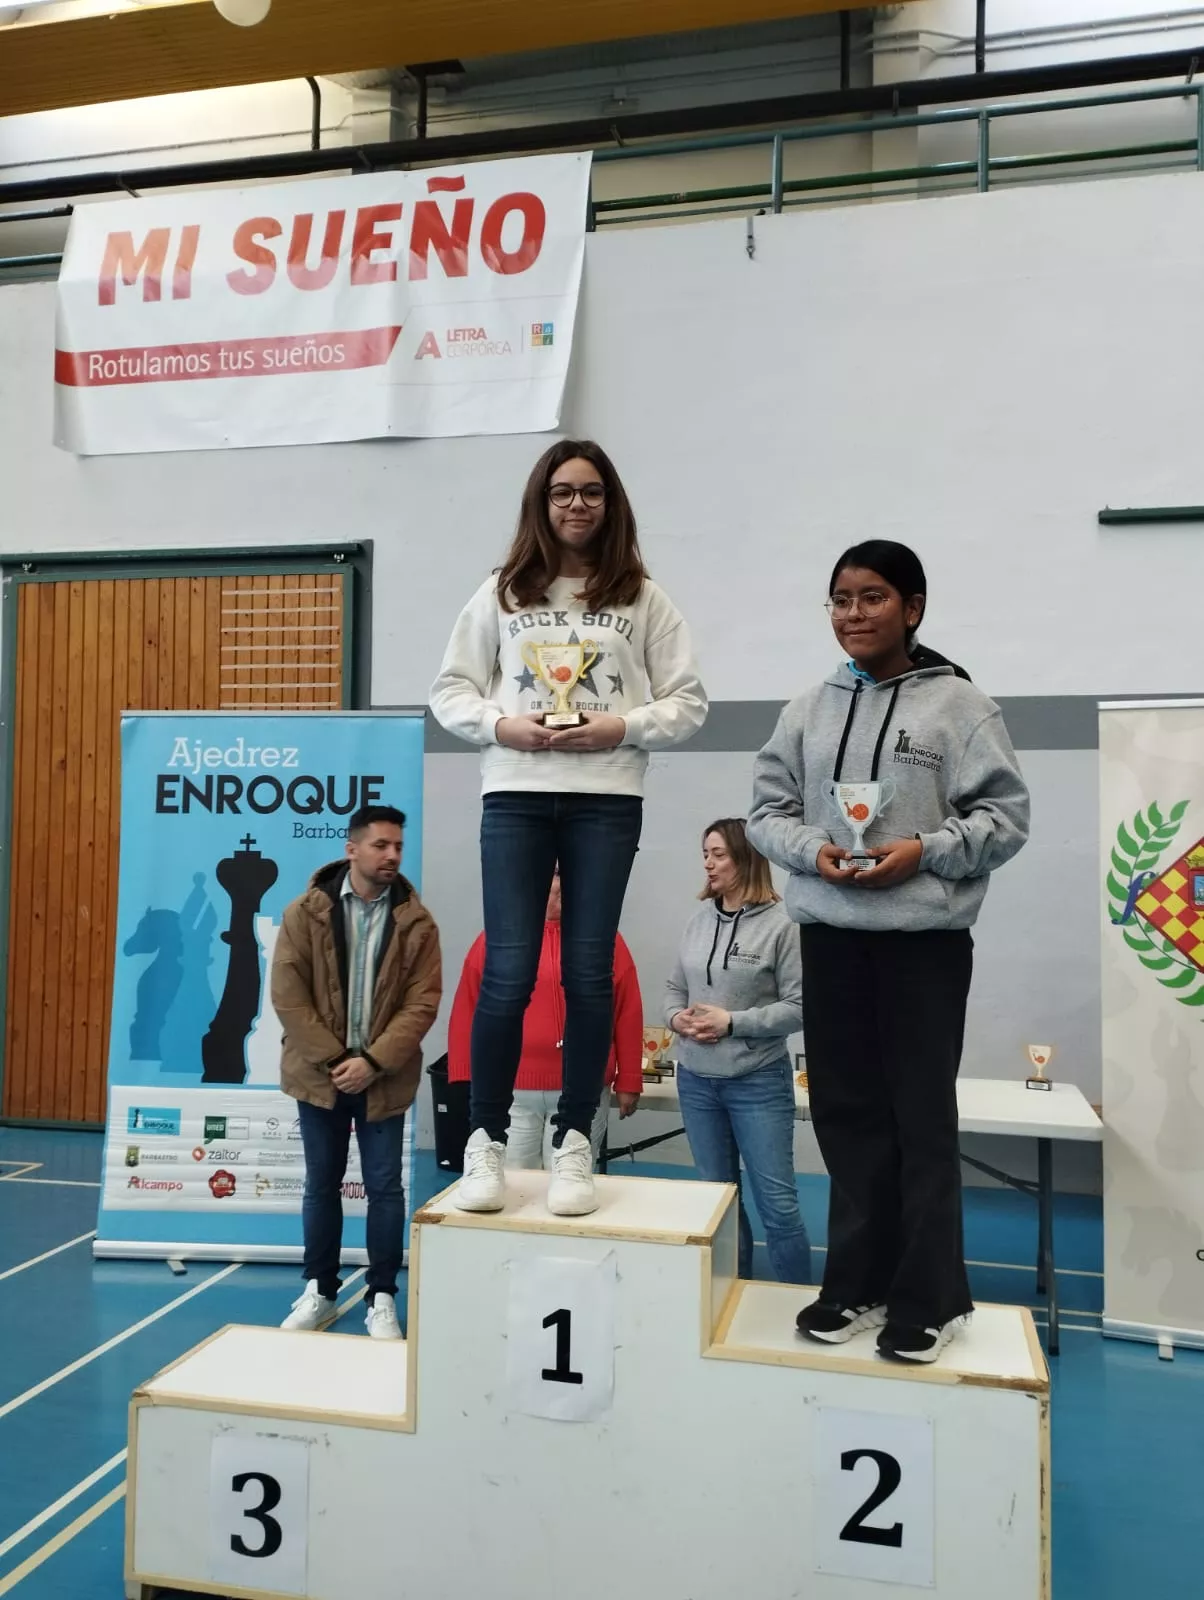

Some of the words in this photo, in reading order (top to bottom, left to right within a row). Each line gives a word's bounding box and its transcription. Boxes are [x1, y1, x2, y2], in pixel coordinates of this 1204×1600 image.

[98, 225, 200, 306] MI
[226, 175, 546, 295] SUEÑO
[447, 328, 487, 342] LETRA
[88, 351, 210, 379] Rotulamos
[219, 347, 256, 370] tus
[262, 339, 345, 367] sueños
[509, 611, 569, 638] ROCK
[582, 612, 634, 645] SOUL
[530, 701, 542, 710] ON
[167, 737, 298, 773] Ajedrez
[893, 753, 941, 772] Barbastro
[910, 747, 944, 762] ENROQUE
[155, 774, 385, 815] ENROQUE
[292, 822, 350, 839] Barba
[208, 1149, 242, 1161] zaitor
[541, 1309, 583, 1385] 1
[230, 1472, 284, 1558] 3
[839, 1448, 904, 1548] 2
